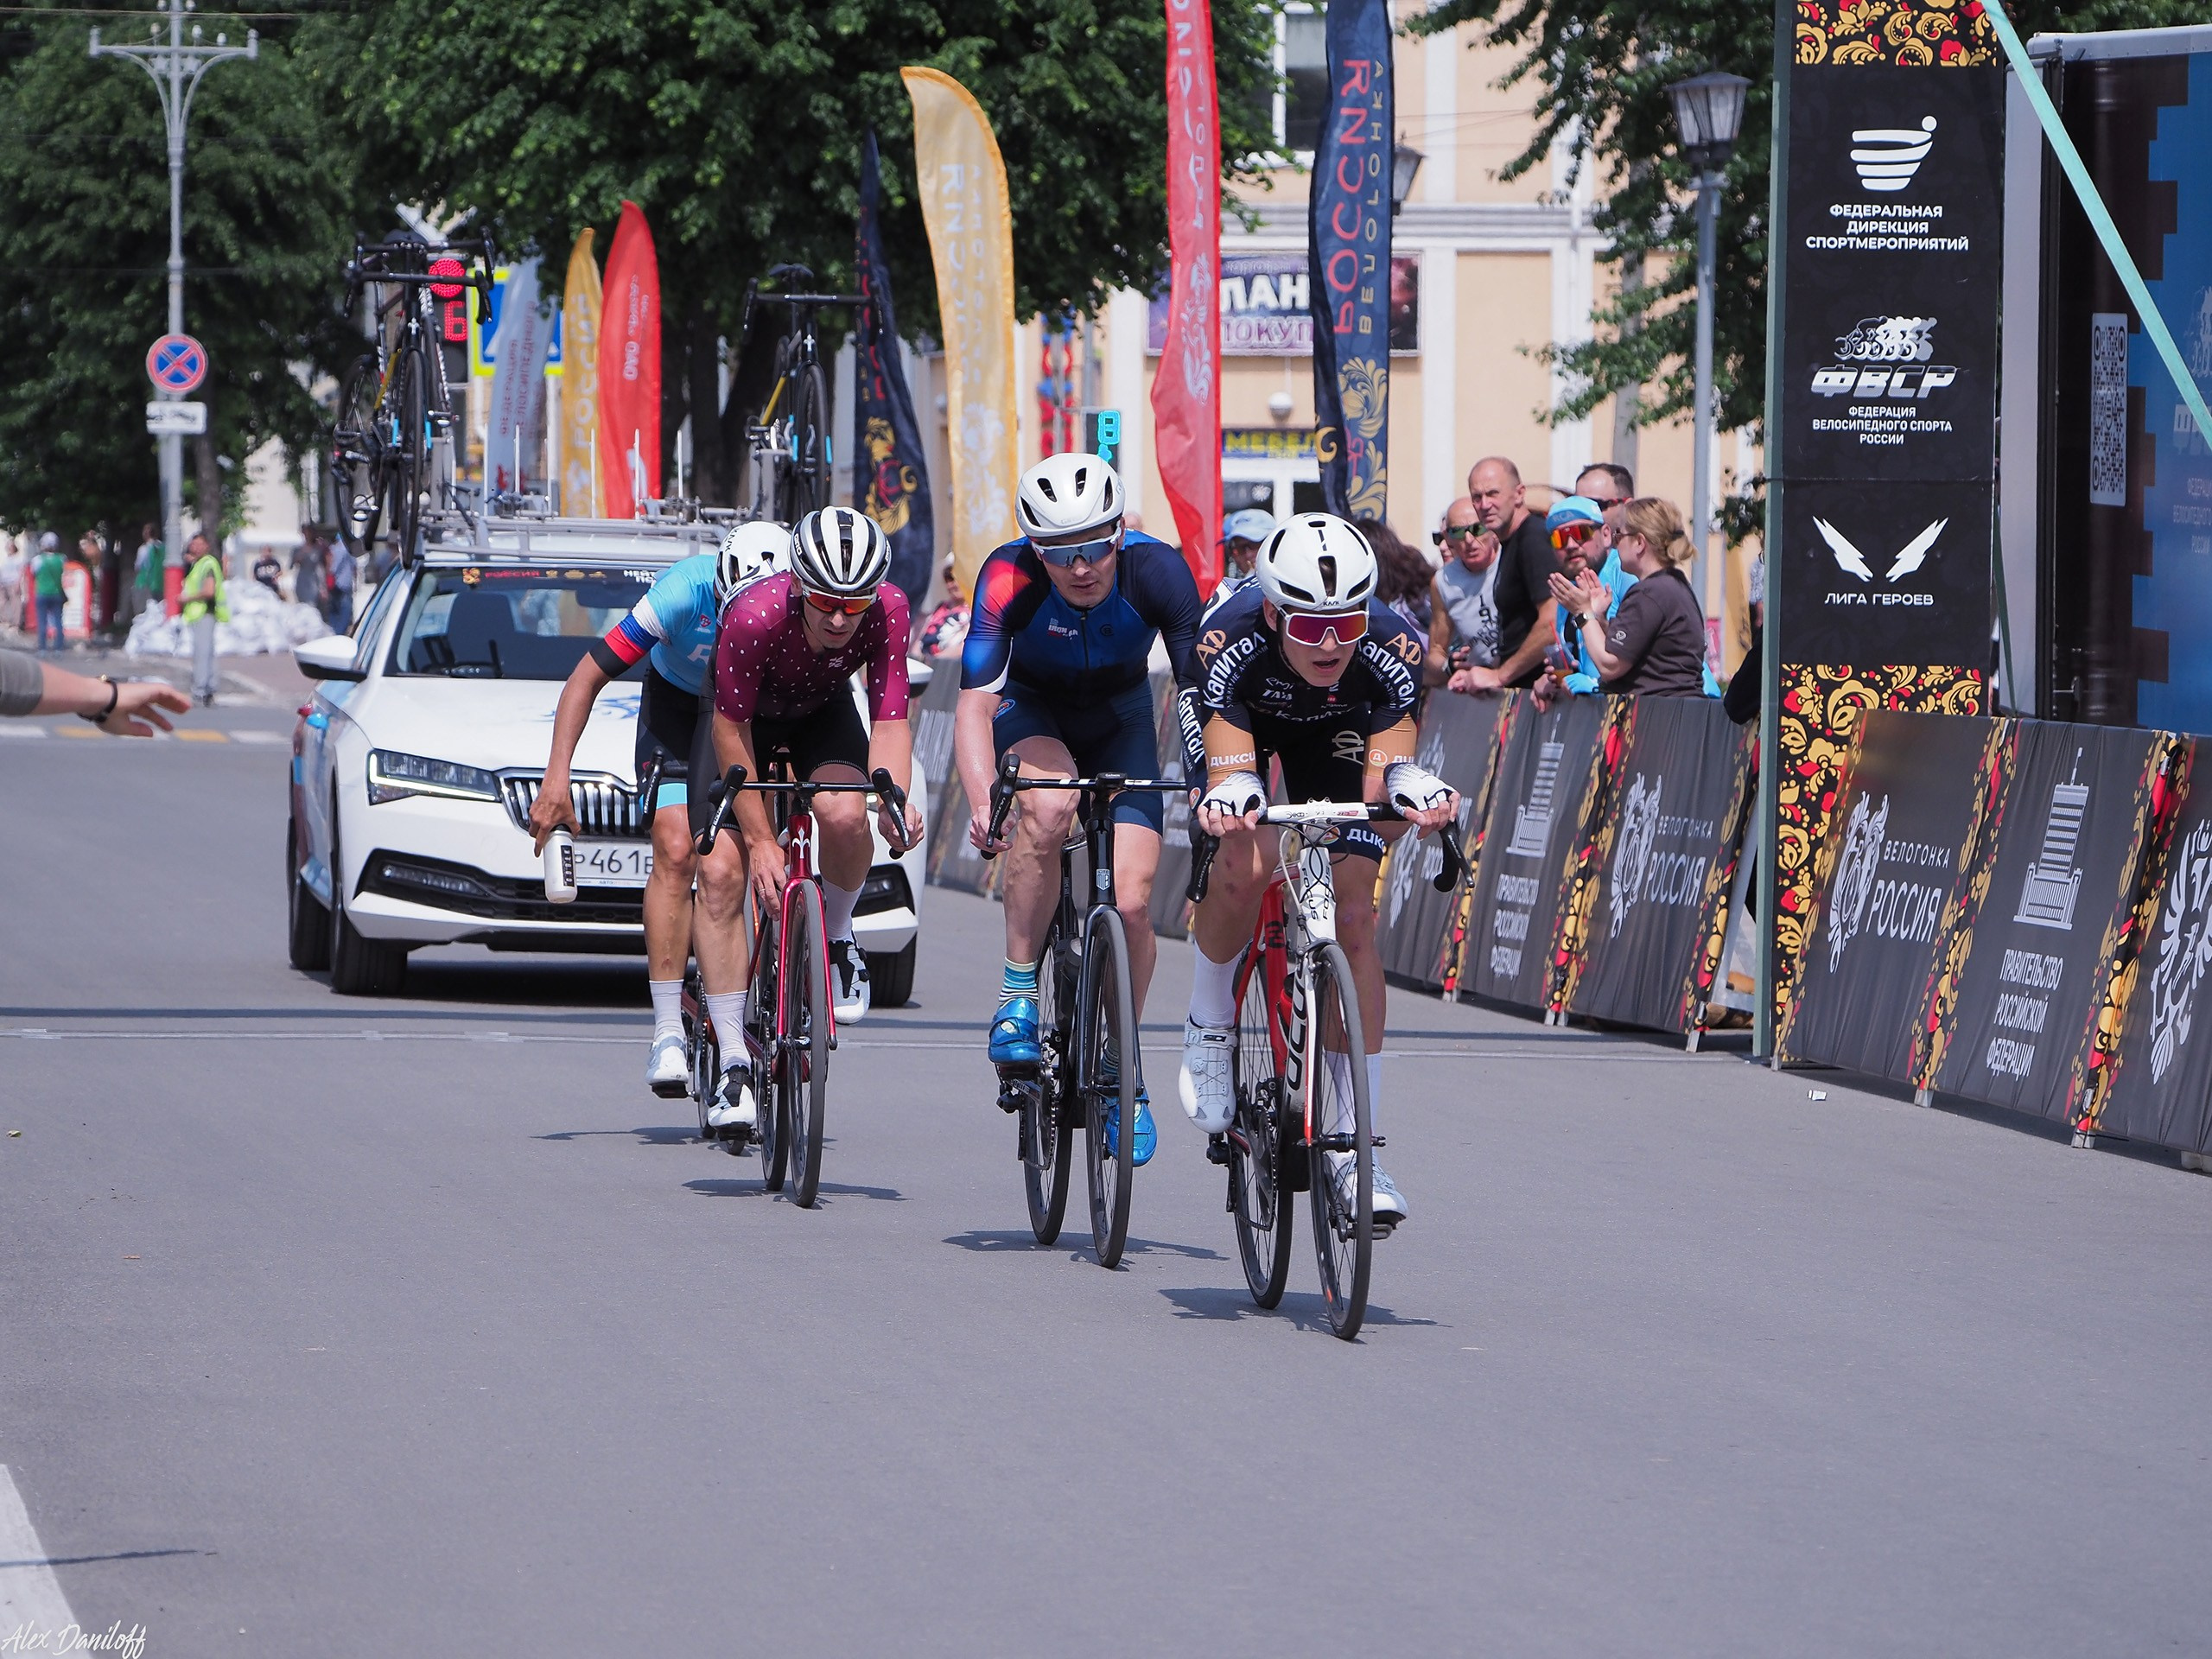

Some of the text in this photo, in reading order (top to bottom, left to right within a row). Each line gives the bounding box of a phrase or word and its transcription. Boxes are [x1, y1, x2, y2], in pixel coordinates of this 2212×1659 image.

[1829, 204, 1943, 219] ФЕДЕРАЛЬНАЯ
[1847, 221, 1929, 235] ДИРЕКЦИЯ
[1805, 235, 1970, 251] СПОРТМЕРОПРИЯТИЙ
[1811, 365, 1957, 399] ФВСР
[1848, 406, 1916, 418] ФЕДЕРАЦИЯ
[1812, 419, 1953, 433] ВЕЛОСИПЕДНОГО СПОРТА
[1859, 434, 1904, 445] РОССИИ
[1824, 593, 1934, 606] ЛИГА ГЕРОЕВ
[1883, 839, 1951, 869] ВЕЛОГОНКА
[1643, 850, 1707, 907] РОССИЯ
[1866, 879, 1942, 944] РОССИЯ
[1999, 948, 2064, 991] ПРАВИТЕЛЬСТВО
[1993, 990, 2049, 1033] РОССИЙСКОЙ
[1986, 1036, 2036, 1082] ФЕДЕРАЦИИ
